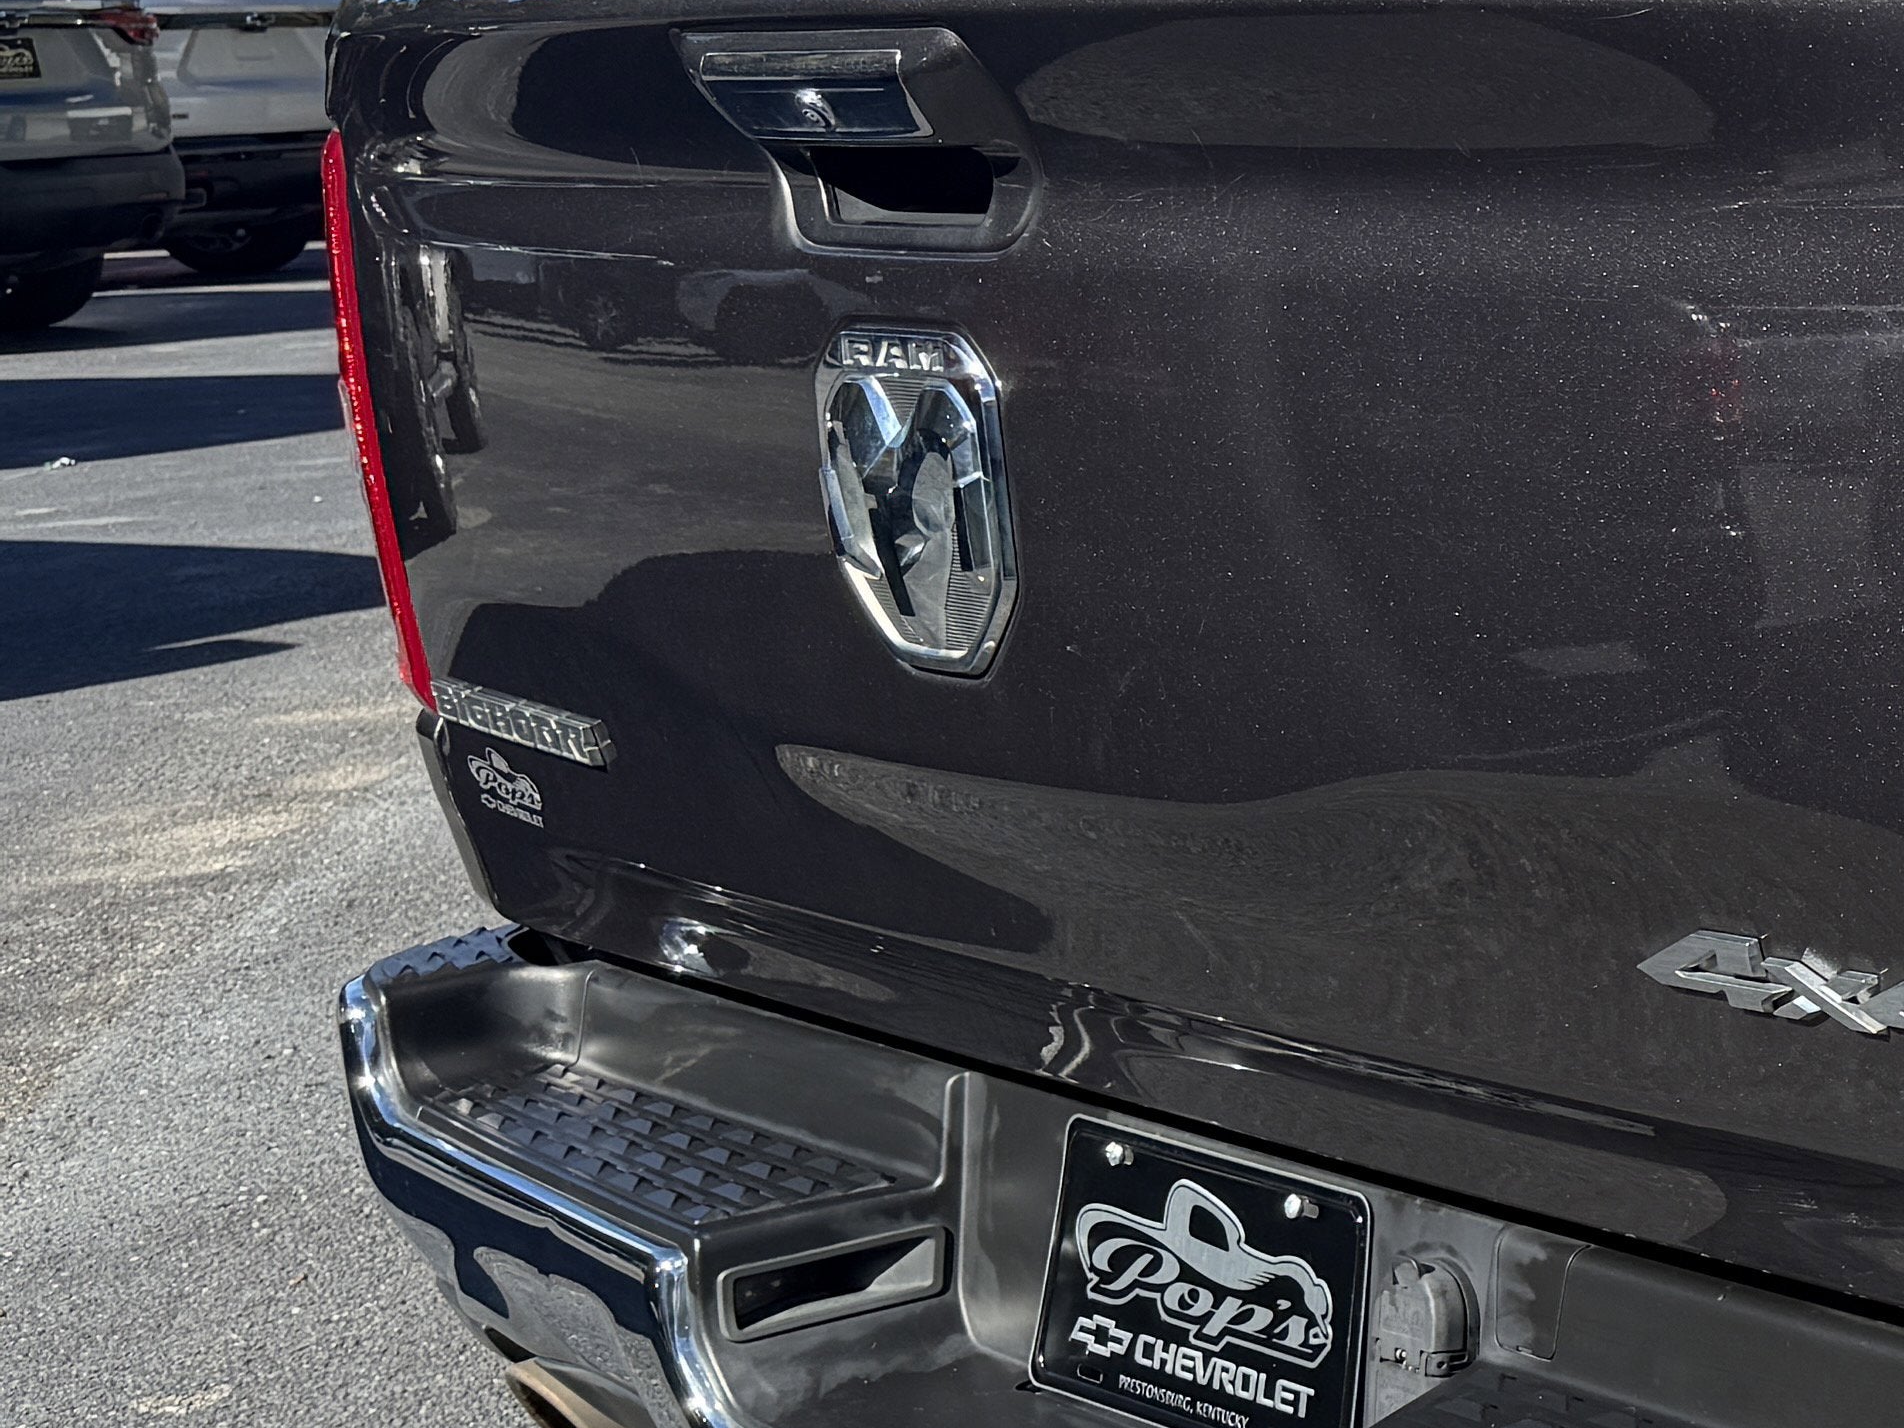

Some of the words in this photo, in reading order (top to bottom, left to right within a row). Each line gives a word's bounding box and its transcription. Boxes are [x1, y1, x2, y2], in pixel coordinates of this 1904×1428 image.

[841, 337, 945, 373] RAM
[1091, 1237, 1314, 1356] Pop's
[1118, 1374, 1194, 1415] PRESTONSBURG,
[1133, 1334, 1316, 1419] CHEVROLET
